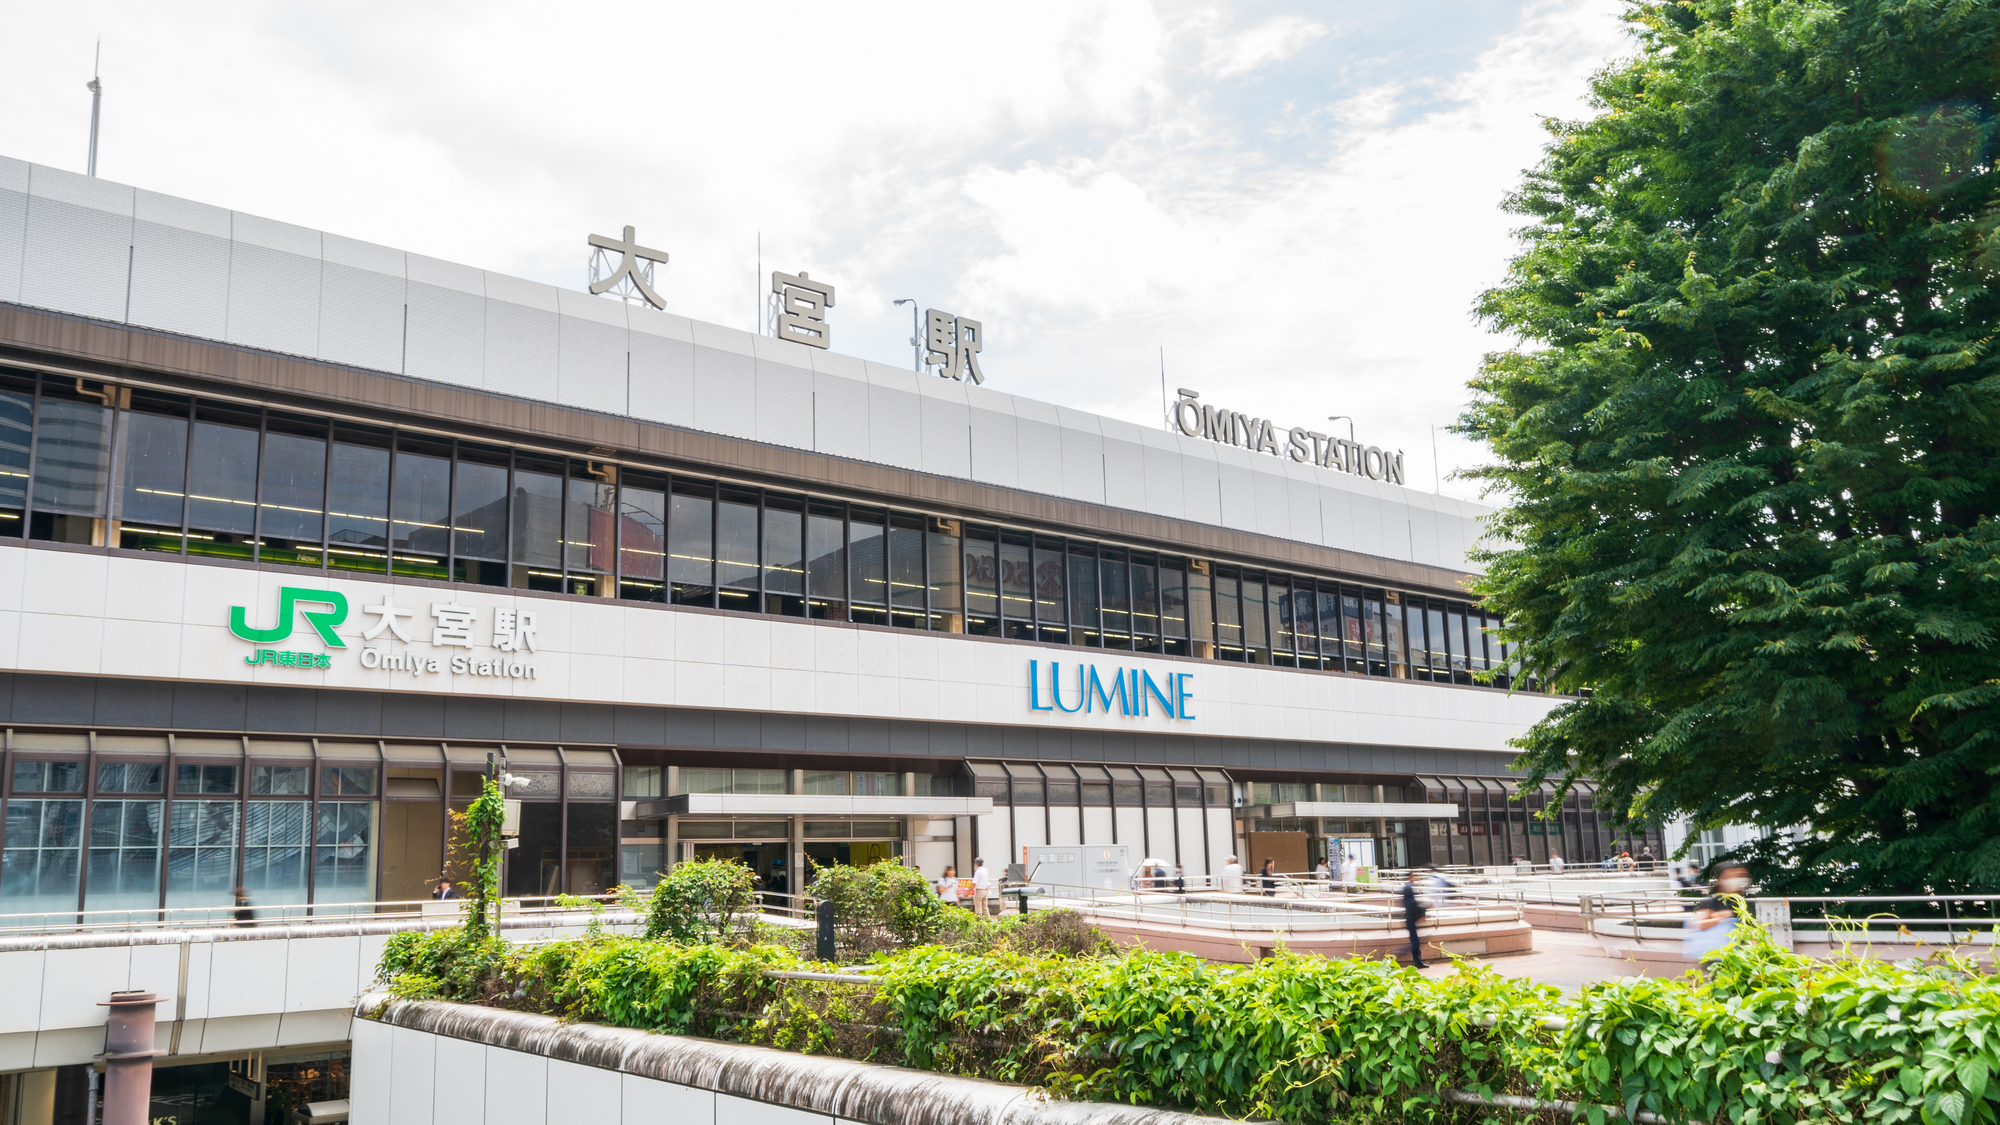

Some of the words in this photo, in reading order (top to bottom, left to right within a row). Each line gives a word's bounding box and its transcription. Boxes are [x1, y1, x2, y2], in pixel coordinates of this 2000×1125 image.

[588, 225, 985, 386] 大宮駅
[1177, 388, 1280, 456] ŌMIYA
[1289, 427, 1406, 486] STATION
[228, 585, 349, 649] JR
[361, 595, 539, 653] 大宮駅
[245, 649, 332, 670] JR東日本
[450, 654, 539, 680] Station
[1029, 659, 1196, 720] LUMINE
